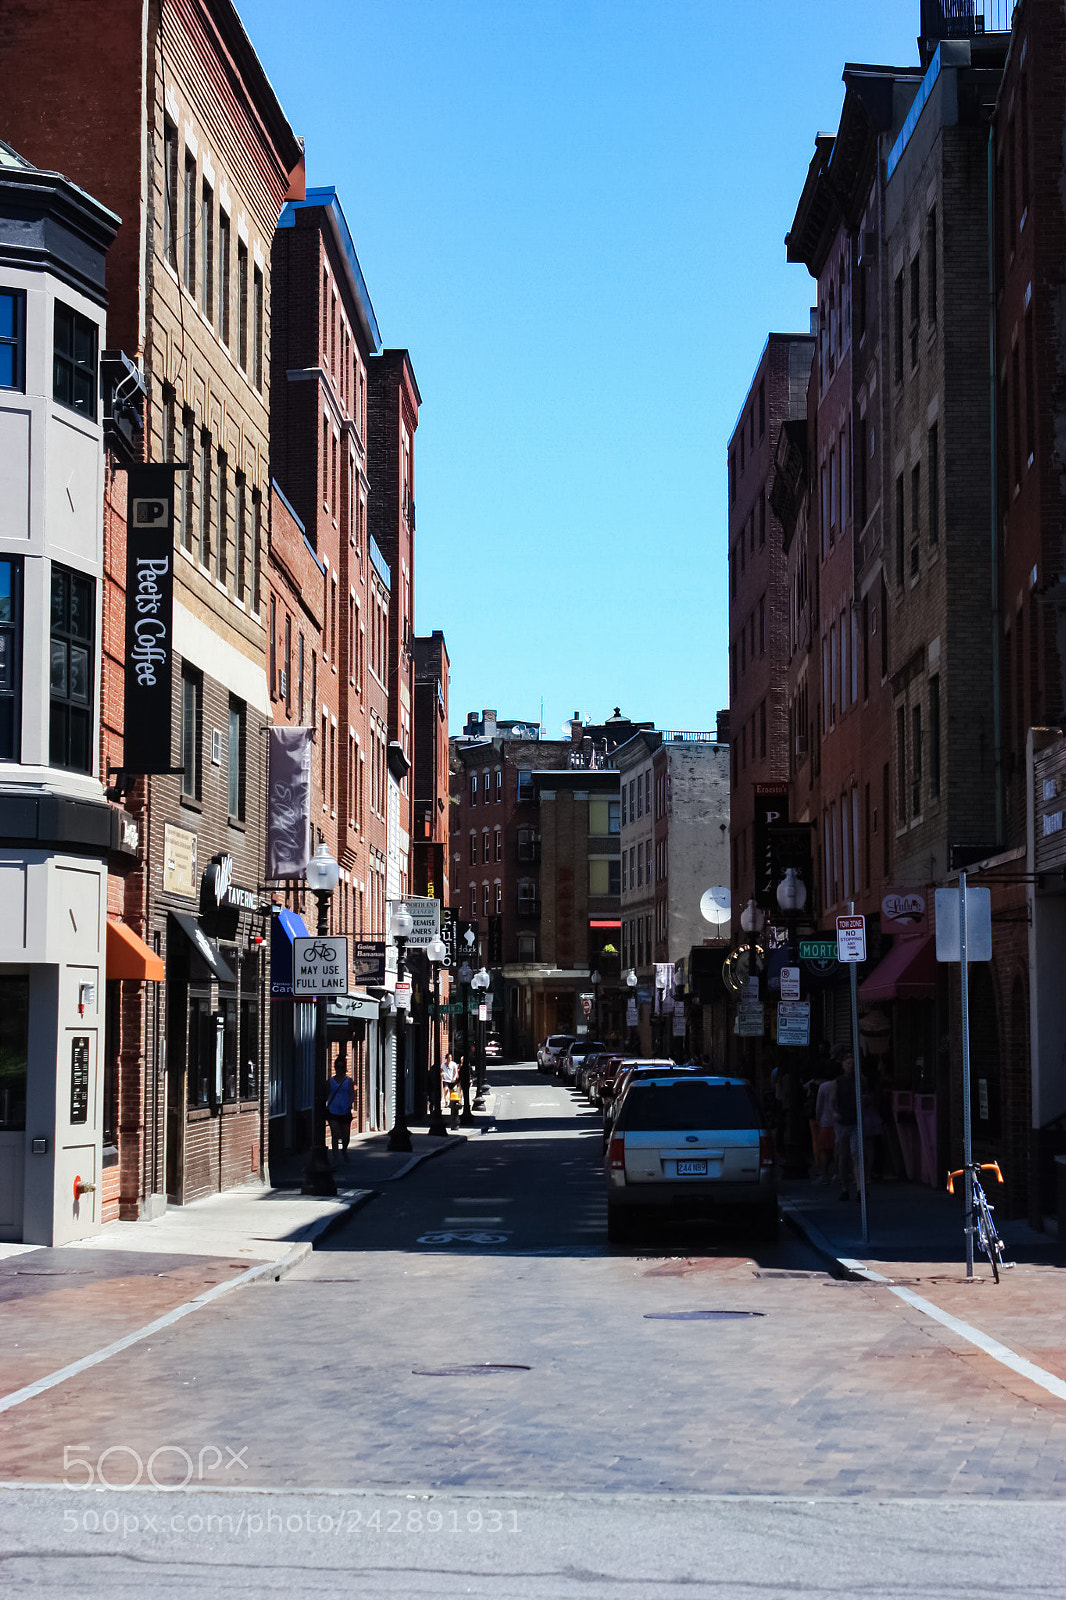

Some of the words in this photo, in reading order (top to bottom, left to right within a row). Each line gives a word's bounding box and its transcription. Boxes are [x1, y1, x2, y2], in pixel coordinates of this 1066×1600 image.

[136, 555, 169, 614] Peet's
[131, 617, 167, 687] Coffee
[756, 784, 787, 793] Ernesto's
[227, 885, 254, 908] TAVERN
[839, 920, 849, 929] TOW
[850, 919, 862, 928] ZONE
[357, 943, 376, 951] Going
[301, 966, 318, 975] MAY
[322, 965, 340, 975] USE
[296, 979, 317, 988] FULL
[322, 978, 344, 988] LANE
